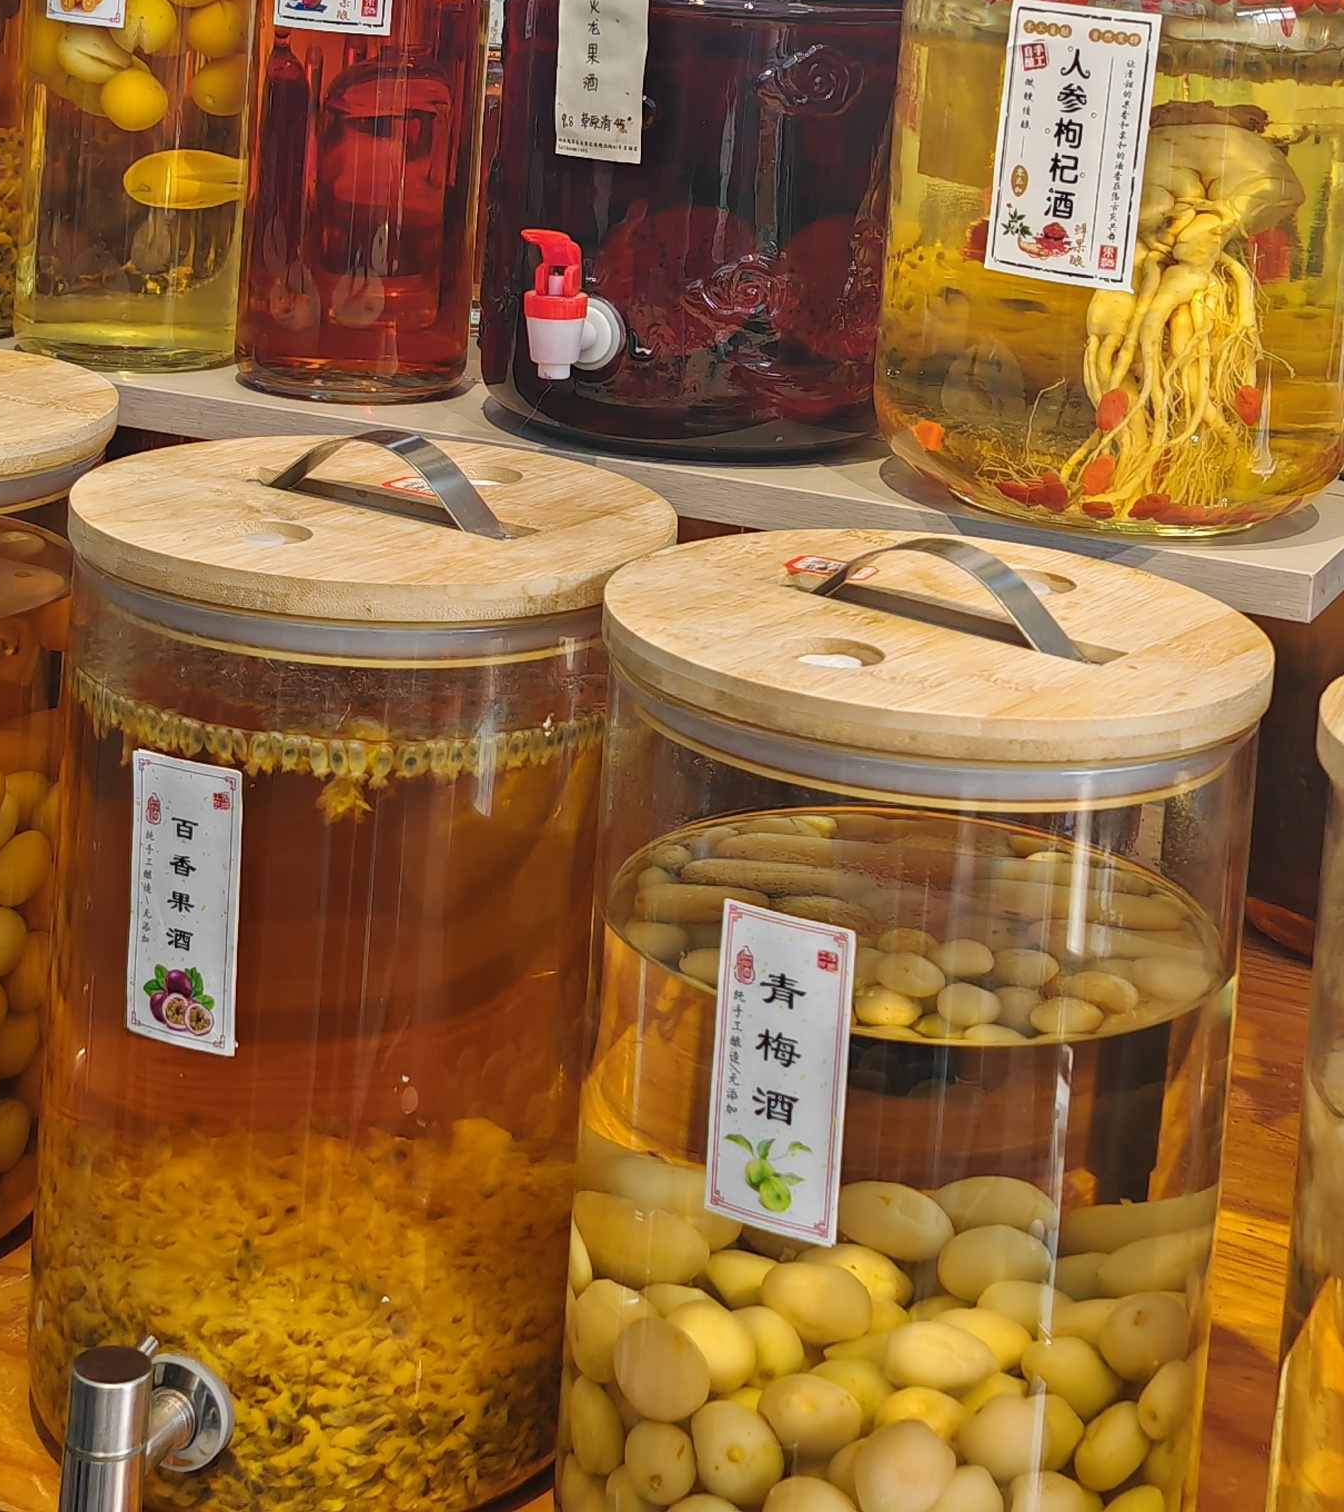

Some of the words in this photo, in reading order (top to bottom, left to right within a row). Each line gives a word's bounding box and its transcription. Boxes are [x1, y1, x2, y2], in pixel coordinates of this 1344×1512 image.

[1044, 48, 1091, 221] 人参枸杞酒
[164, 815, 199, 953] 百香果酒
[750, 971, 807, 1127] 青梅酒
